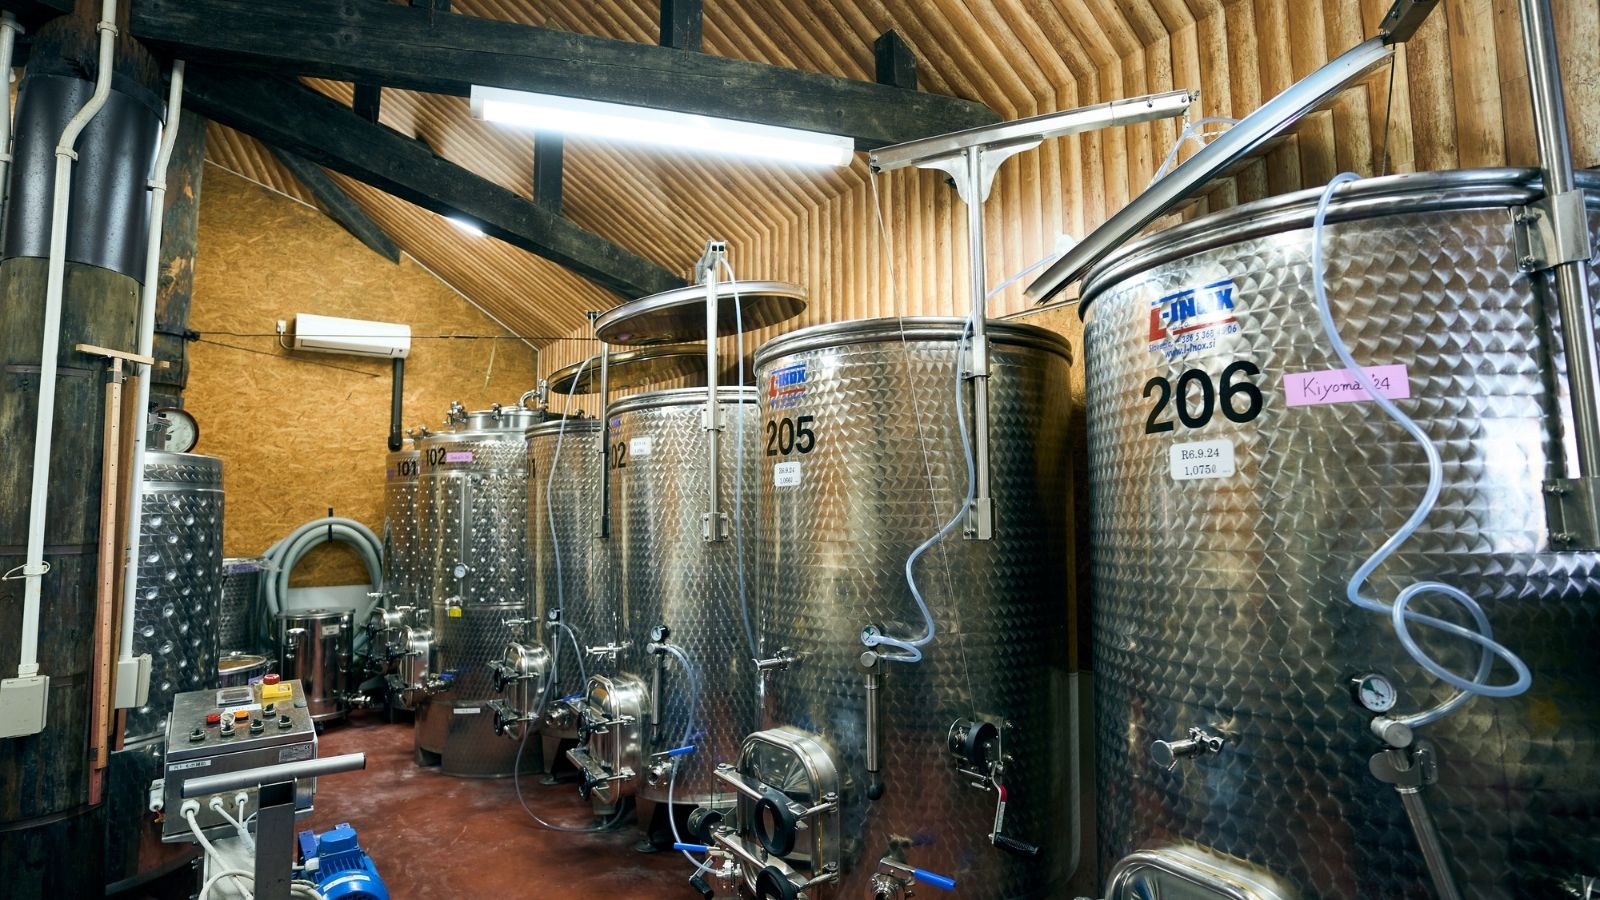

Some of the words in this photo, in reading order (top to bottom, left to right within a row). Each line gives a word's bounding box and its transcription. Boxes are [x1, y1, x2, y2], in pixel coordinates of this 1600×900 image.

[1143, 361, 1263, 434] 206
[767, 415, 815, 456] 205
[426, 447, 446, 467] 102
[1181, 448, 1220, 460] R6.9.24
[397, 460, 416, 476] 101
